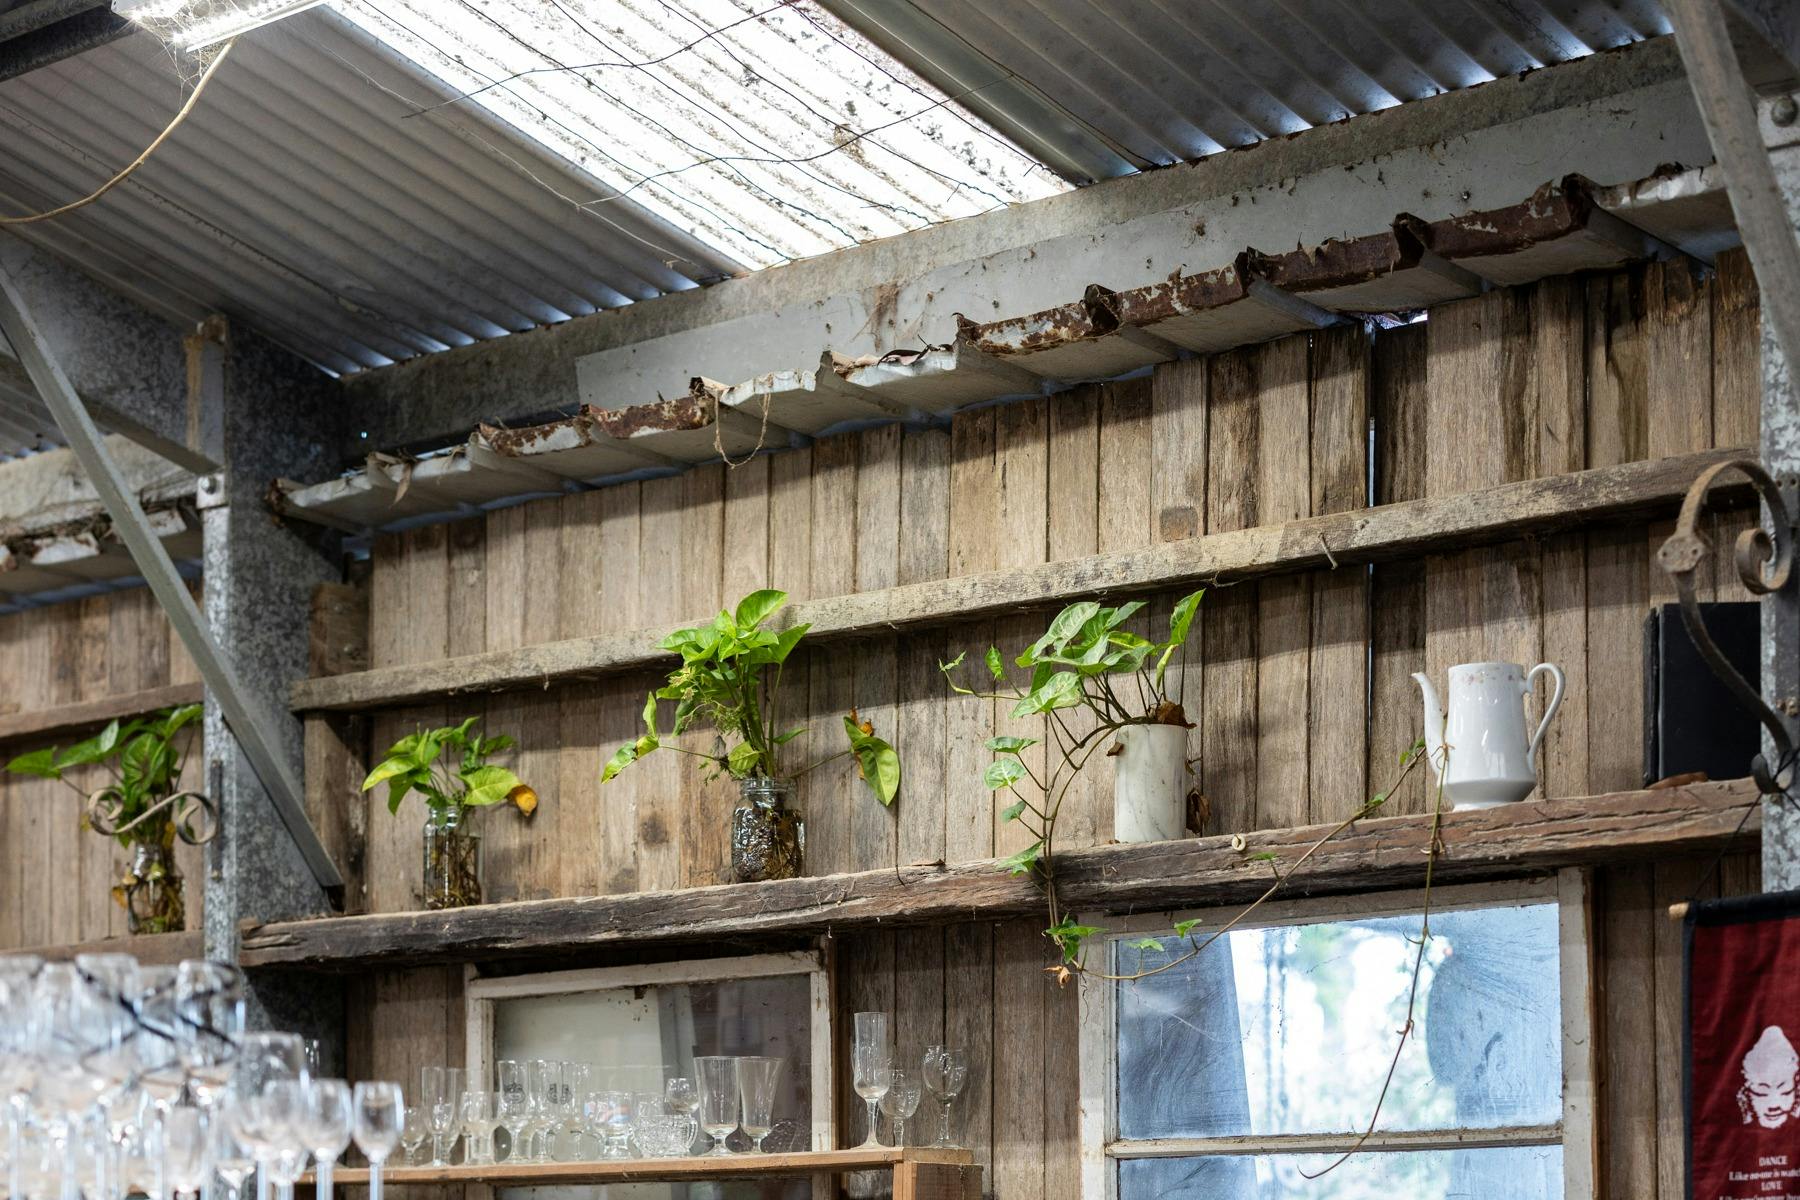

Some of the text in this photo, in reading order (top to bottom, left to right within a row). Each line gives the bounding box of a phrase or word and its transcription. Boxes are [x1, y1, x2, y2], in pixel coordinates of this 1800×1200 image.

[1759, 1156, 1787, 1166] DANCE
[1729, 1171, 1749, 1181] Like
[1761, 1181, 1782, 1191] LOVE
